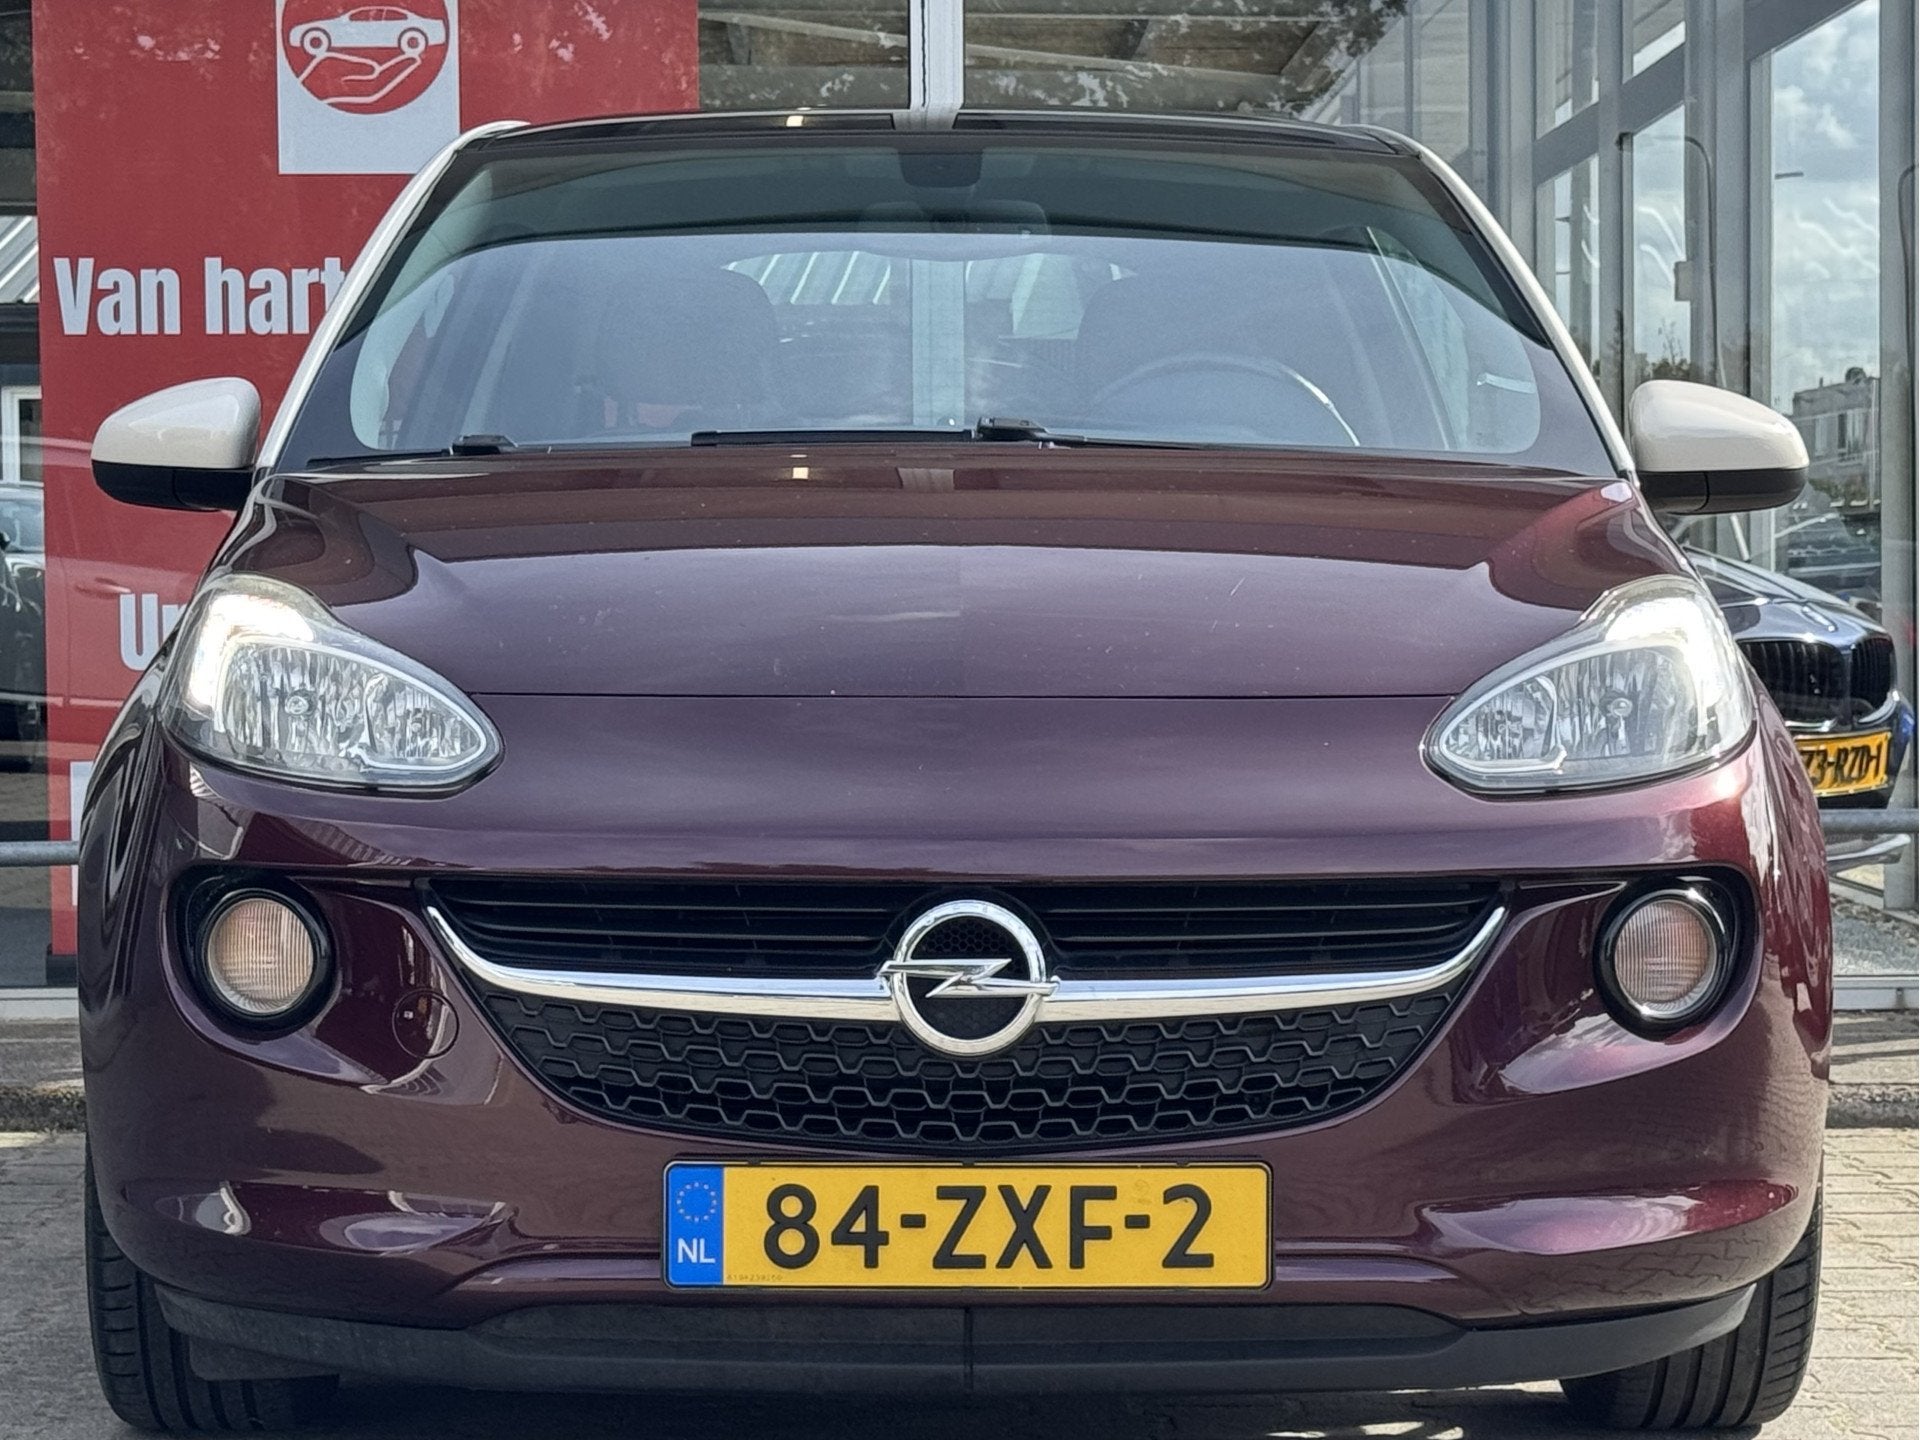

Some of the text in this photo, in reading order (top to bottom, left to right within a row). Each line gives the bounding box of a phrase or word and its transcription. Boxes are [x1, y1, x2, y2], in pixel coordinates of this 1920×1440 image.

[53, 256, 181, 336] Van
[677, 1237, 716, 1264] NL
[763, 1183, 1214, 1270] 84-ZXF-2
